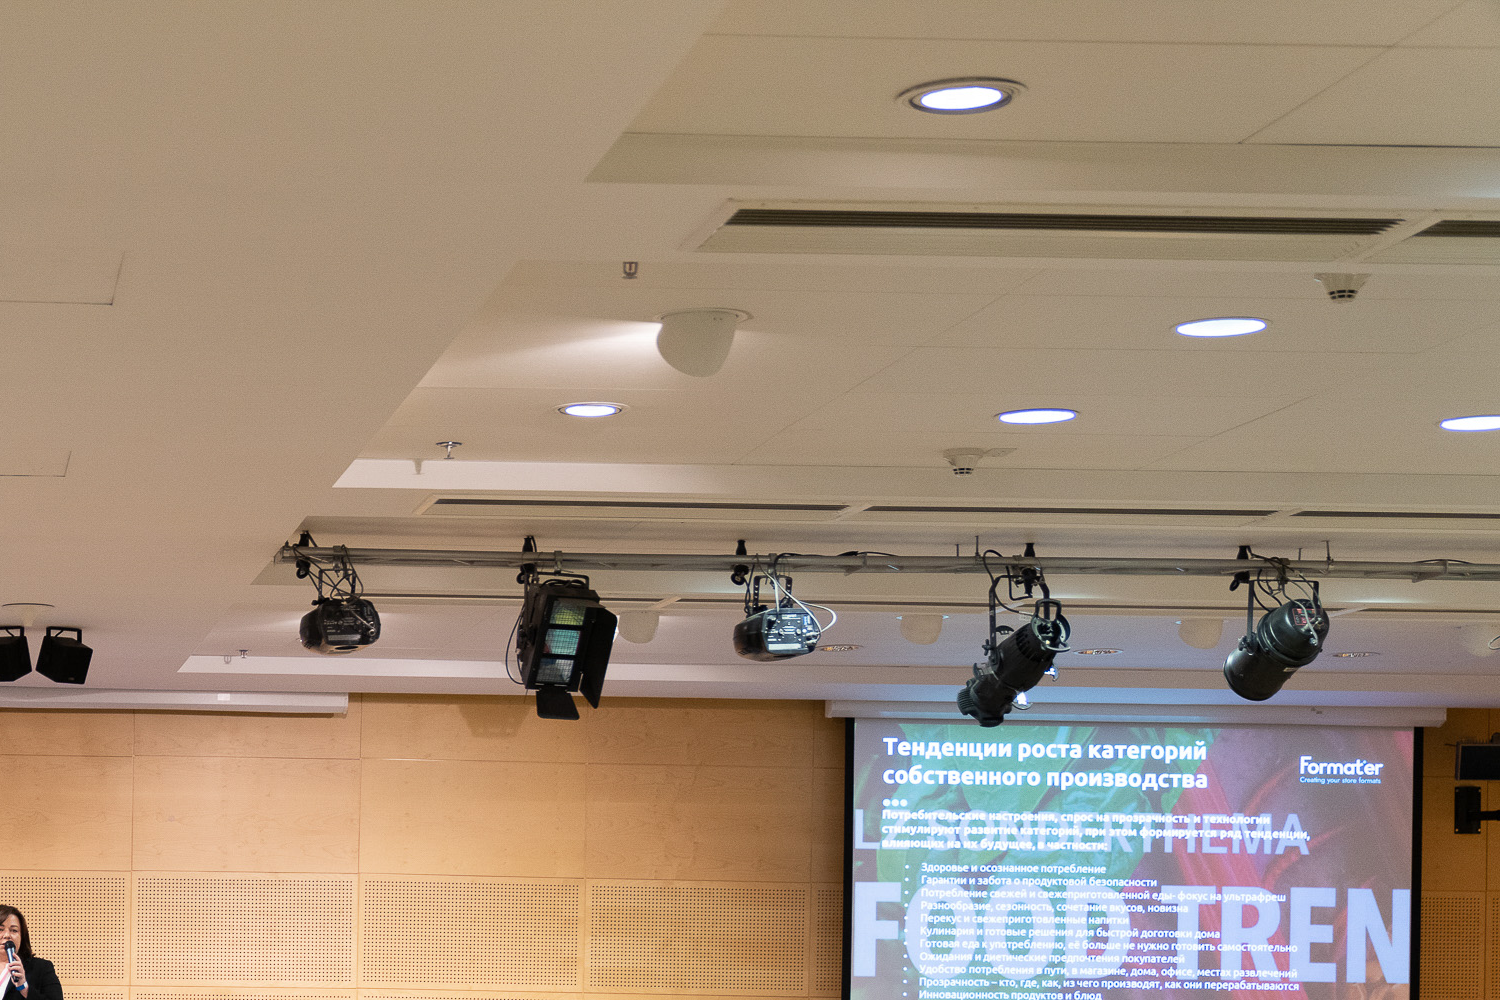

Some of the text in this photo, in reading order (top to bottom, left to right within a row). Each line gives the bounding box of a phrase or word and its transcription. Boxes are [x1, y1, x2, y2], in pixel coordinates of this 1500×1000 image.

[882, 737, 1208, 763] Тенденции роста категорий
[882, 764, 1208, 791] собственного производства
[1300, 776, 1326, 785] Creating
[881, 808, 986, 822] Потребительские
[987, 812, 1058, 823] настроения,
[1059, 813, 1093, 823] спрос
[1111, 814, 1191, 824] прозрачность
[1202, 815, 1270, 824] технологии
[881, 825, 961, 835] стимулируют
[962, 826, 1017, 836] развитие
[1018, 824, 1083, 837] категорий,
[1084, 828, 1107, 837] при
[1108, 828, 1137, 836] этом
[1138, 826, 1218, 839] формируется
[1219, 830, 1242, 839] ряд
[927, 809, 1310, 856] SONDERTHEMA
[881, 839, 945, 849] влияющих
[946, 840, 961, 848] на
[979, 838, 1035, 851] будущее,
[1036, 841, 1045, 849] в
[1046, 841, 1108, 850] частности:
[920, 862, 969, 873] Здоровье
[1040, 863, 1107, 874] потребление
[921, 875, 967, 885] Гарантии
[977, 875, 1011, 884] забота
[1021, 876, 1087, 887] продуктовой
[1088, 876, 1157, 886] безопасности
[920, 887, 988, 899] Потребление
[989, 888, 1027, 897] свежей
[1036, 889, 1150, 901] свежеприготовленной
[1177, 890, 1208, 901] фокус
[1223, 891, 1286, 902] ультрафреш
[920, 900, 994, 911] Разнообразие,
[995, 903, 1054, 912] сезонность,
[1108, 905, 1146, 913] вкусов,
[919, 913, 962, 924] Перекус
[971, 916, 1086, 925] свежеприготовленные
[855, 881, 1131, 981] FOOD
[920, 926, 975, 936] Кулинария
[1027, 929, 1073, 938] решения
[1074, 929, 1094, 937] для
[1095, 927, 1139, 938] быстрой
[1140, 930, 1192, 938] доготовки
[1193, 931, 1220, 939] дома
[920, 939, 960, 947] Готовая
[961, 941, 980, 949] еда
[989, 938, 1066, 950] употреблению,
[1067, 940, 1080, 949] её
[1081, 940, 1121, 949] больше
[1136, 943, 1169, 951] нужно
[919, 952, 972, 962] Ожидания
[982, 954, 1047, 962] диетические
[1048, 955, 1120, 963] предпочтения
[1120, 953, 1185, 964] покупателей
[919, 963, 967, 974] Удобство
[967, 964, 1034, 975] потребления
[1043, 967, 1070, 976] пути,
[1079, 968, 1129, 976] магазине,
[1129, 968, 1159, 977] дома,
[1160, 966, 1195, 977] офисе,
[1232, 967, 1298, 978] развлечений
[918, 977, 989, 987] Прозрачность
[998, 979, 1018, 988] кто,
[1019, 980, 1040, 988] где,
[1040, 980, 1061, 988] как,
[1100, 981, 1162, 989] производят,
[1203, 979, 1300, 991] перерабатываются
[918, 990, 1009, 1000] Инновационность
[1010, 992, 1063, 1000] продуктов
[1073, 990, 1101, 1000] блюд
